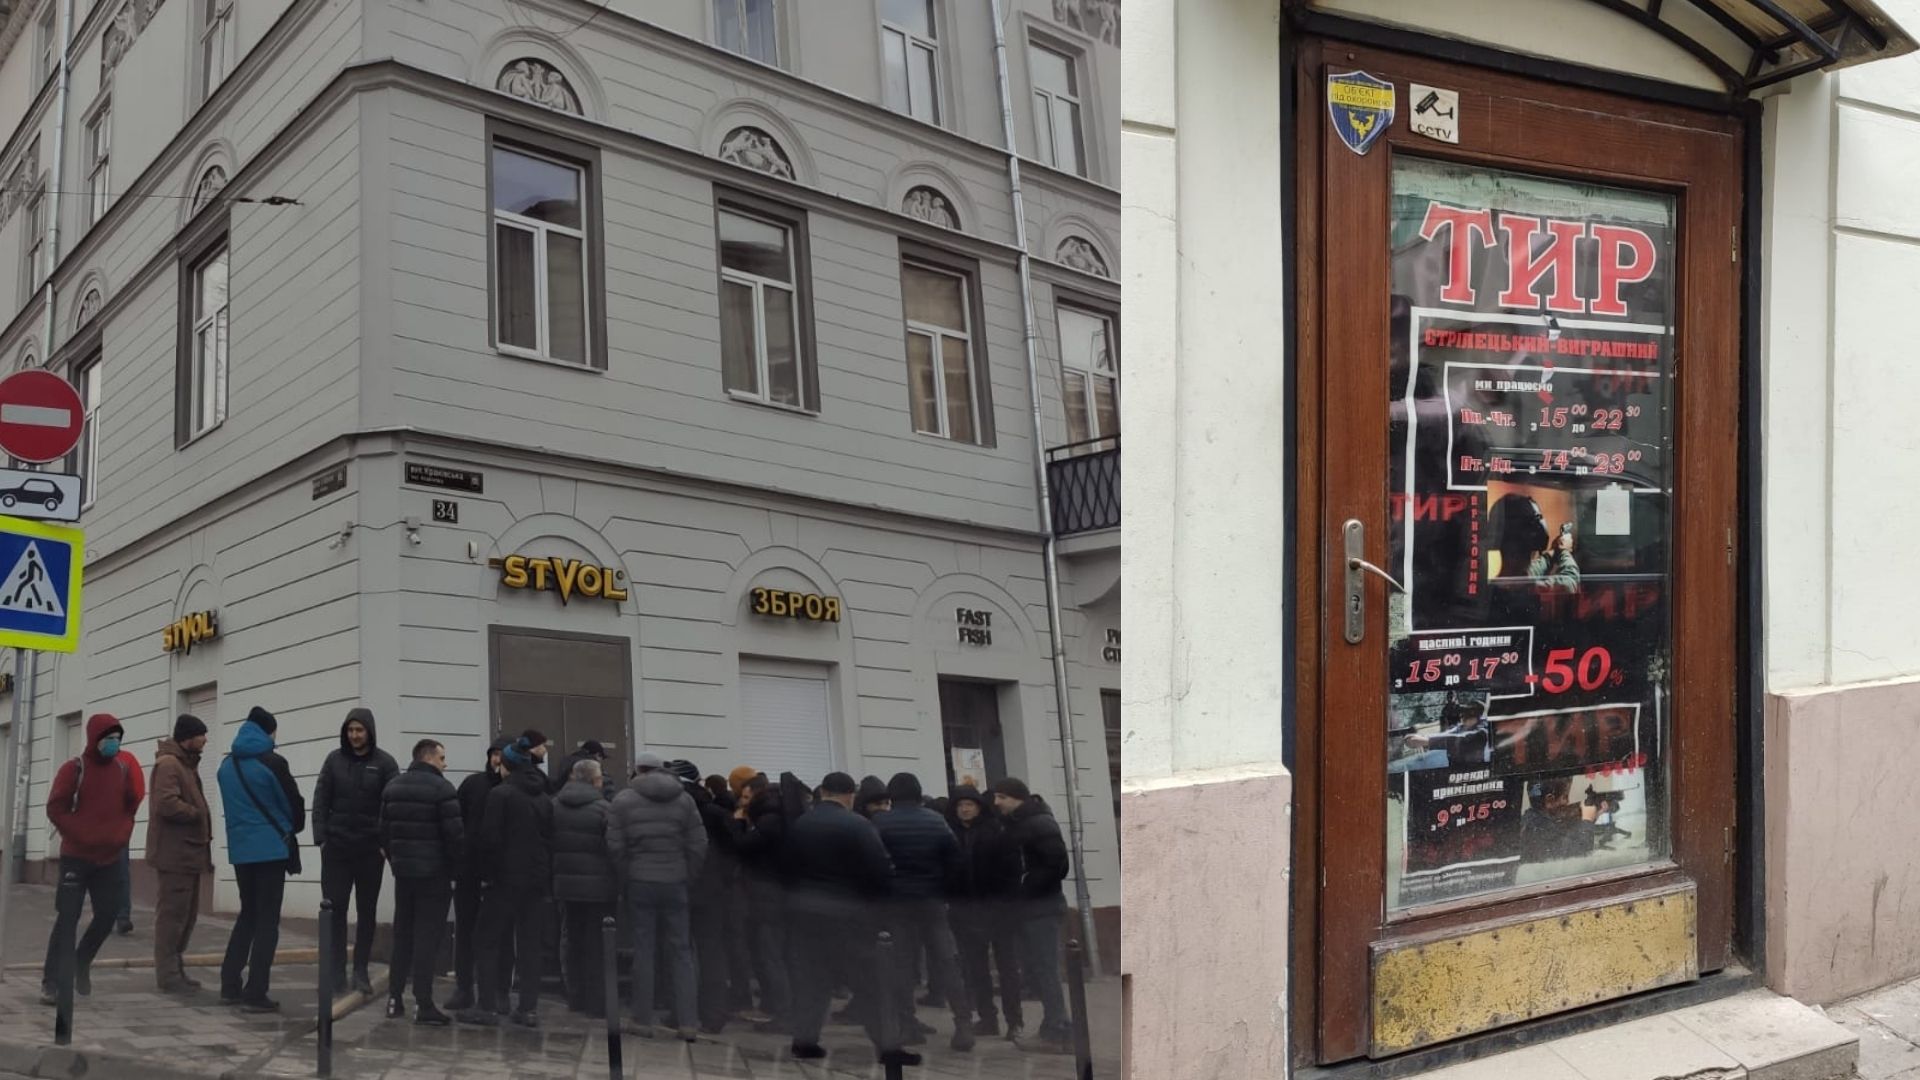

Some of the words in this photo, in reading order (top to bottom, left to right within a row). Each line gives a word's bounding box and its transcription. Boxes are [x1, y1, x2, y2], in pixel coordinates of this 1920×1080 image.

[1417, 124, 1452, 139] CCTV
[1419, 200, 1657, 316] ТИР
[436, 502, 456, 520] 34
[503, 554, 628, 606] STVOL
[752, 587, 841, 622] ЗБРОЯ
[956, 608, 992, 627] FAST
[162, 610, 216, 656] STVOL
[957, 627, 992, 645] FISH
[1448, 769, 1490, 784] оренда
